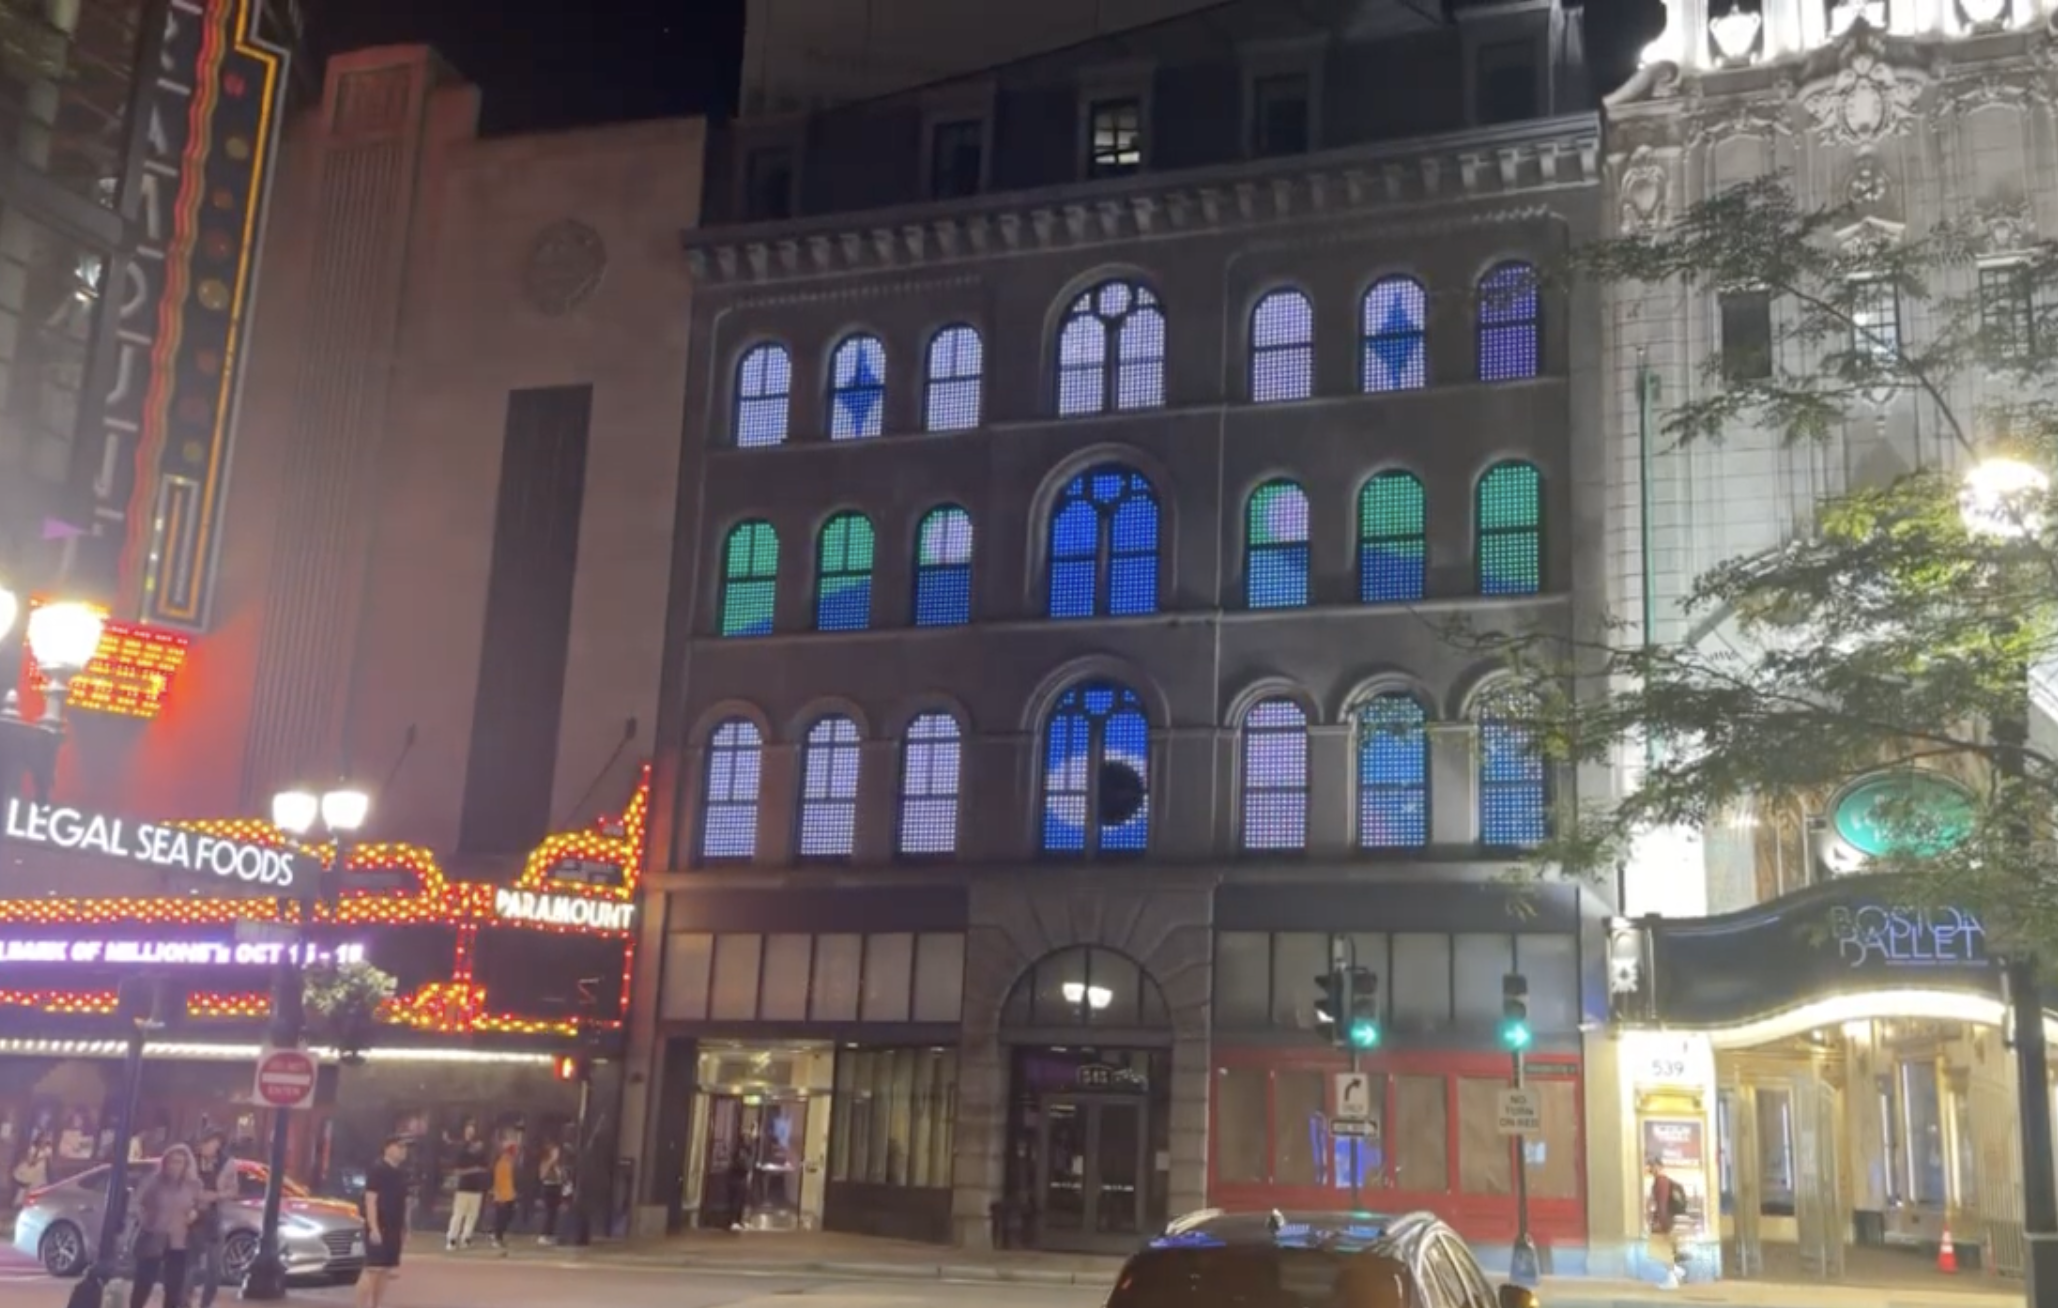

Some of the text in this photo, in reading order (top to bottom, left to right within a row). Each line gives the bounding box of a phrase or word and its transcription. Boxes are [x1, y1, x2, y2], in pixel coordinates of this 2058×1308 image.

[5, 797, 294, 886] LEGAL SEA FOODS
[495, 888, 635, 929] PARAMOUNT
[1840, 925, 1979, 968] BALLET
[1651, 1059, 1685, 1077] 539
[1509, 1094, 1527, 1104] NO
[1504, 1106, 1535, 1116] TURN
[1499, 1117, 1540, 1128] ON RED
